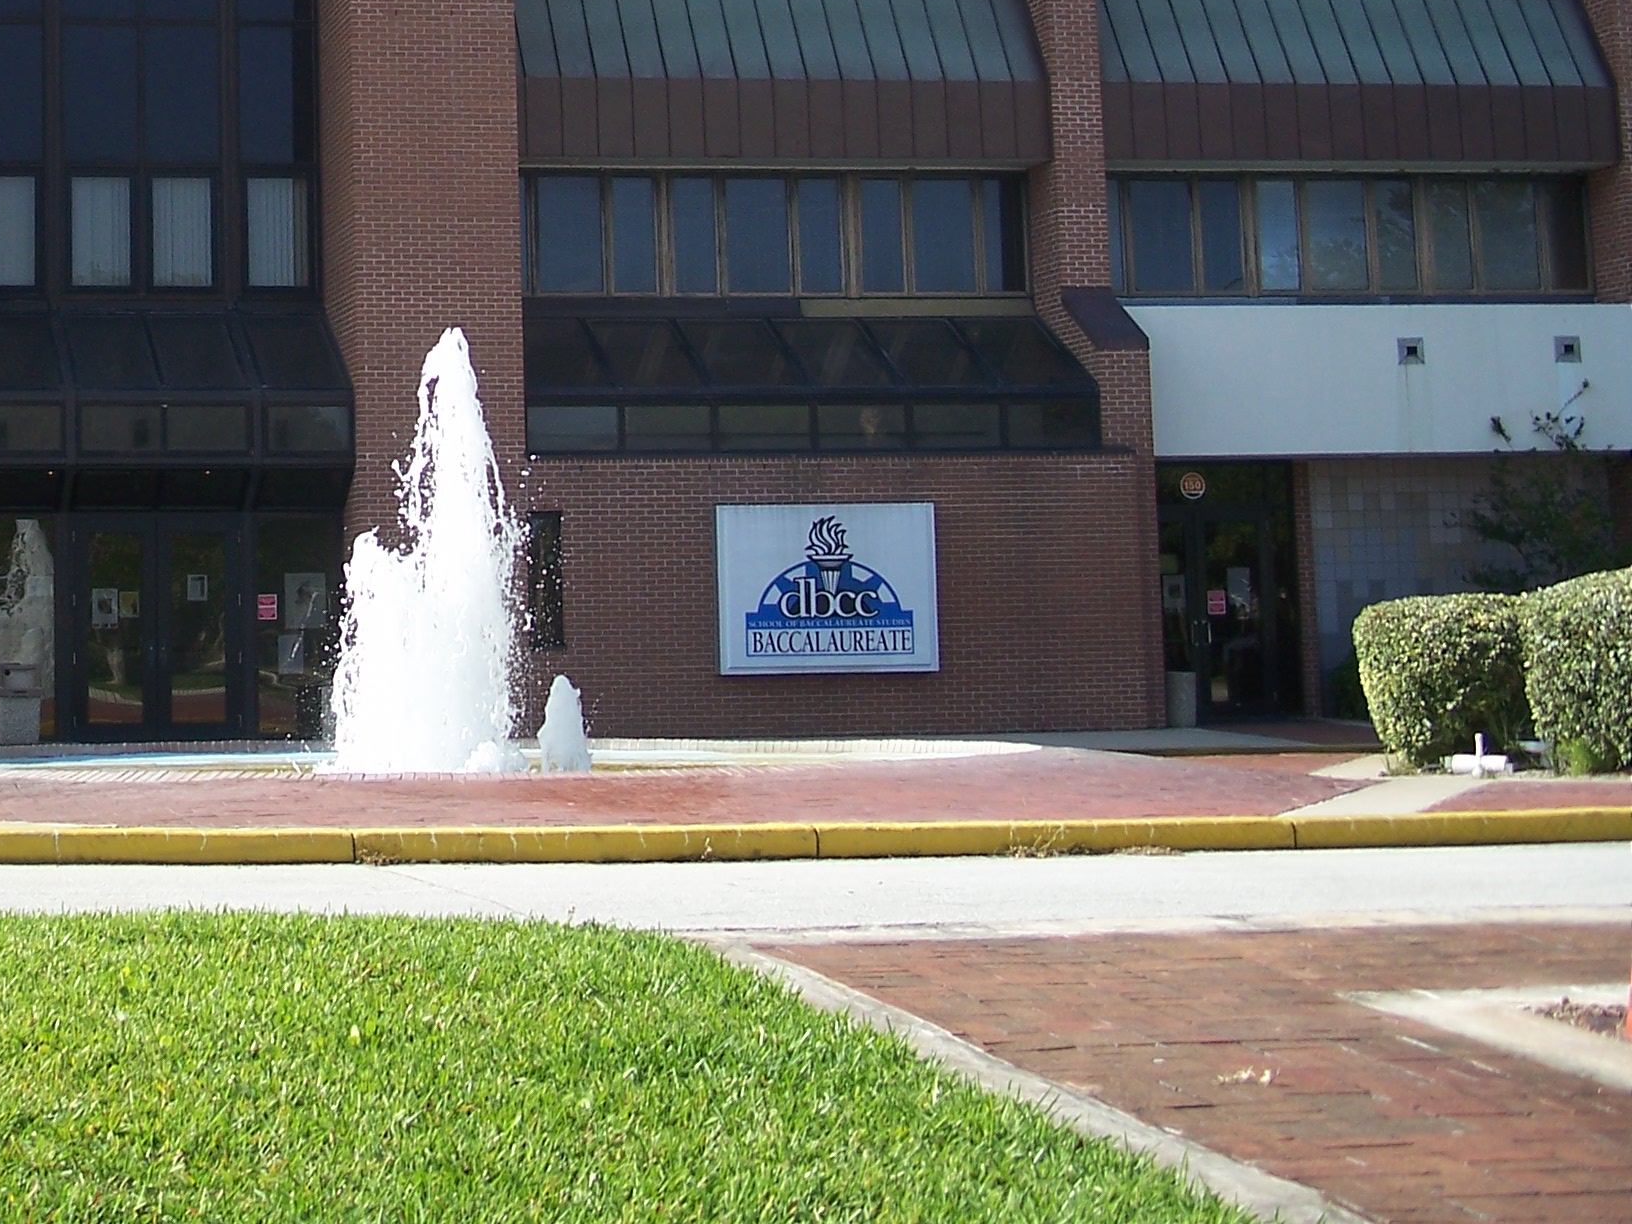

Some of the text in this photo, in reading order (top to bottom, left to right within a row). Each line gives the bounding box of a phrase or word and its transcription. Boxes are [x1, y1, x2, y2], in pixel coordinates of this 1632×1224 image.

[1184, 481, 1201, 490] 150
[780, 577, 879, 618] dbcc
[748, 620, 783, 628] SCHOOL
[800, 619, 873, 628] BACCALAUREATE
[753, 629, 911, 653] BACCALAUREATE
